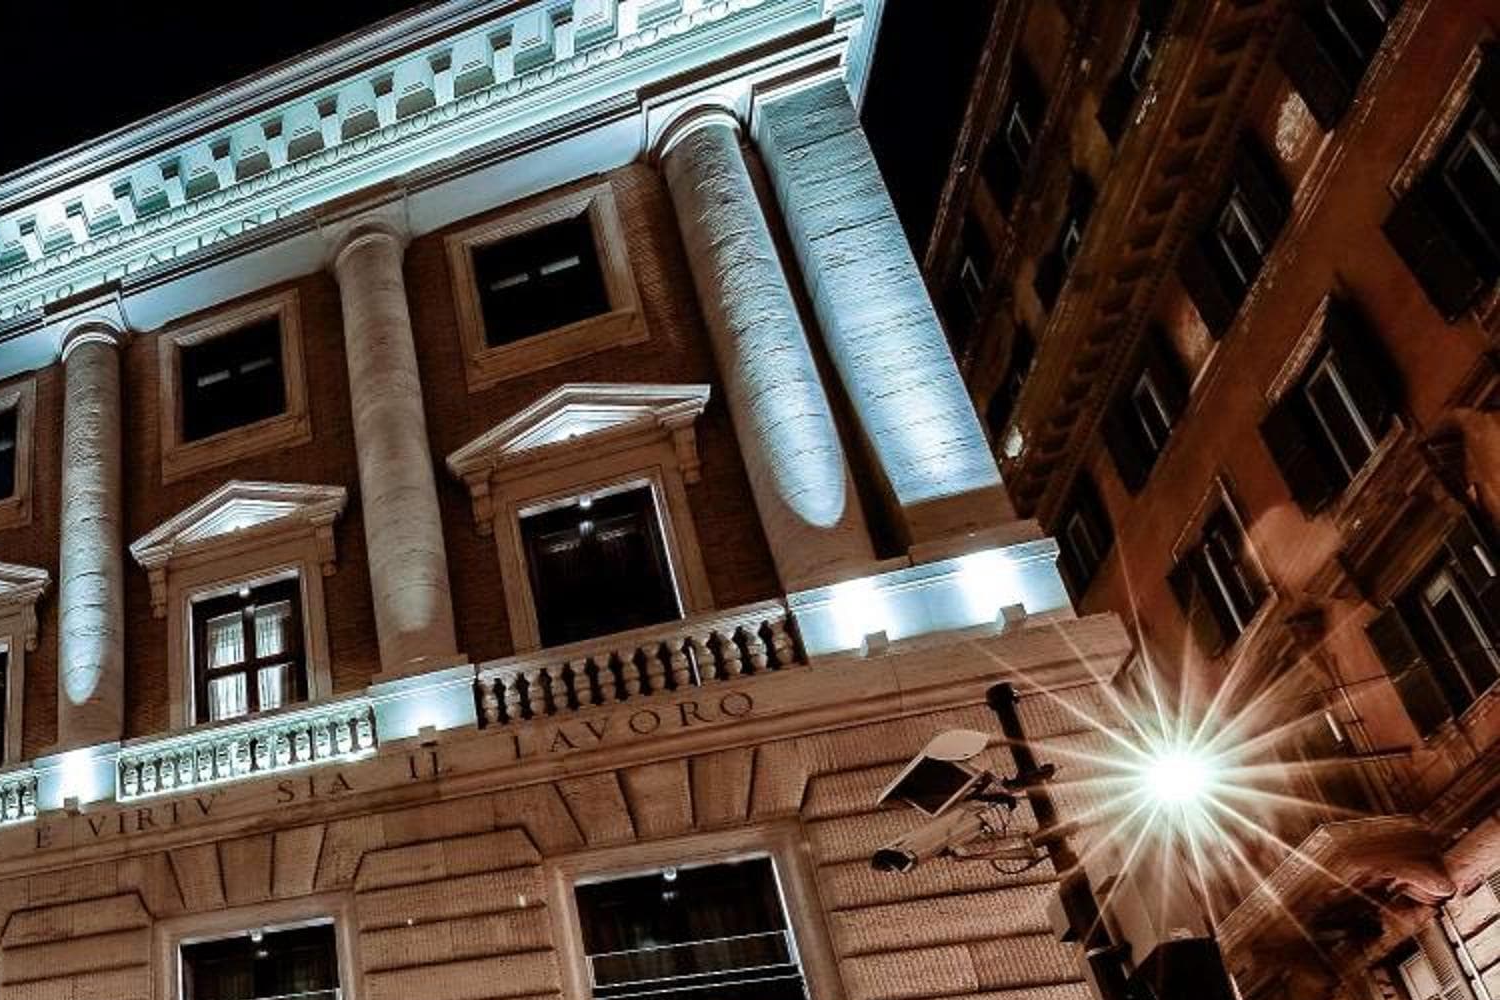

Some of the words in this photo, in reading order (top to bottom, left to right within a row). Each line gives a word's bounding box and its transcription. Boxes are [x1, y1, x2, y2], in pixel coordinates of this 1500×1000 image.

[35, 825, 53, 850] E
[276, 770, 355, 804] SIA
[511, 688, 756, 762] LAVORO
